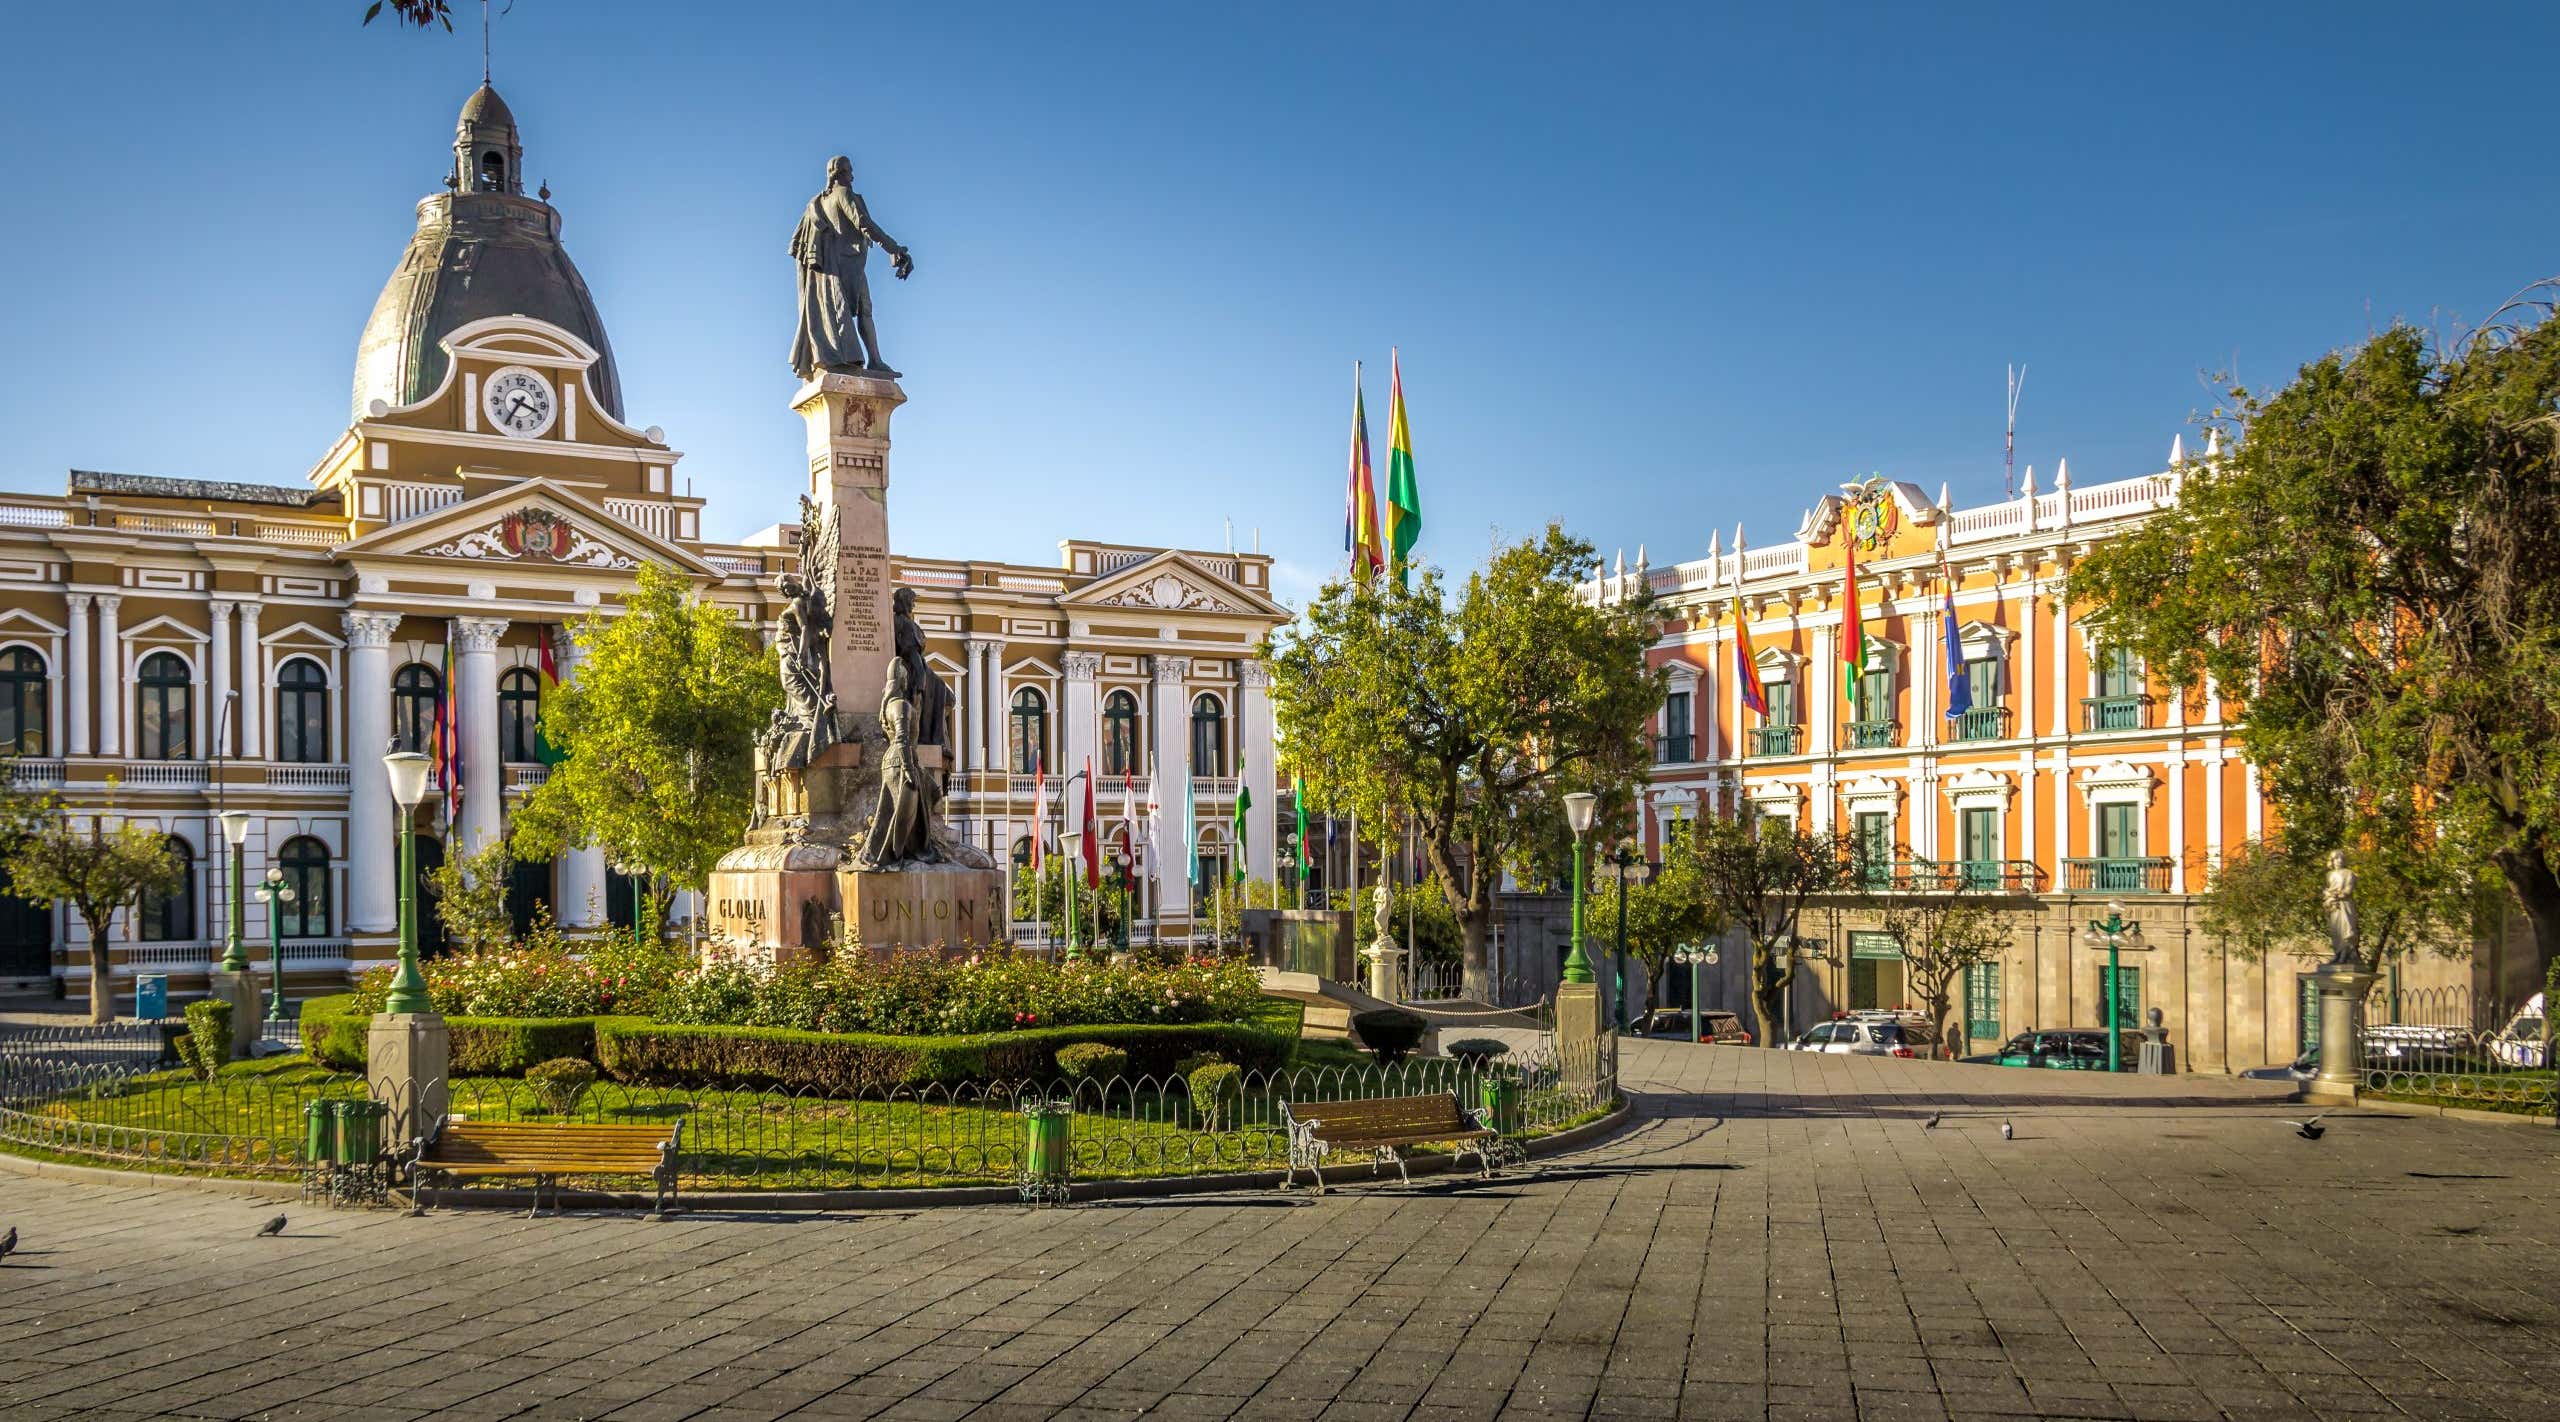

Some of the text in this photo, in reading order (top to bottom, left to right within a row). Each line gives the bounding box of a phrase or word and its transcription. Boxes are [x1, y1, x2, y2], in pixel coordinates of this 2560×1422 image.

[515, 378, 526, 386] 12
[493, 397, 499, 405] 3
[540, 402, 546, 410] 9
[516, 420, 522, 428] 6
[843, 566, 879, 576] LA PAZ
[719, 899, 767, 920] GLORIA
[872, 899, 975, 922] UNION
